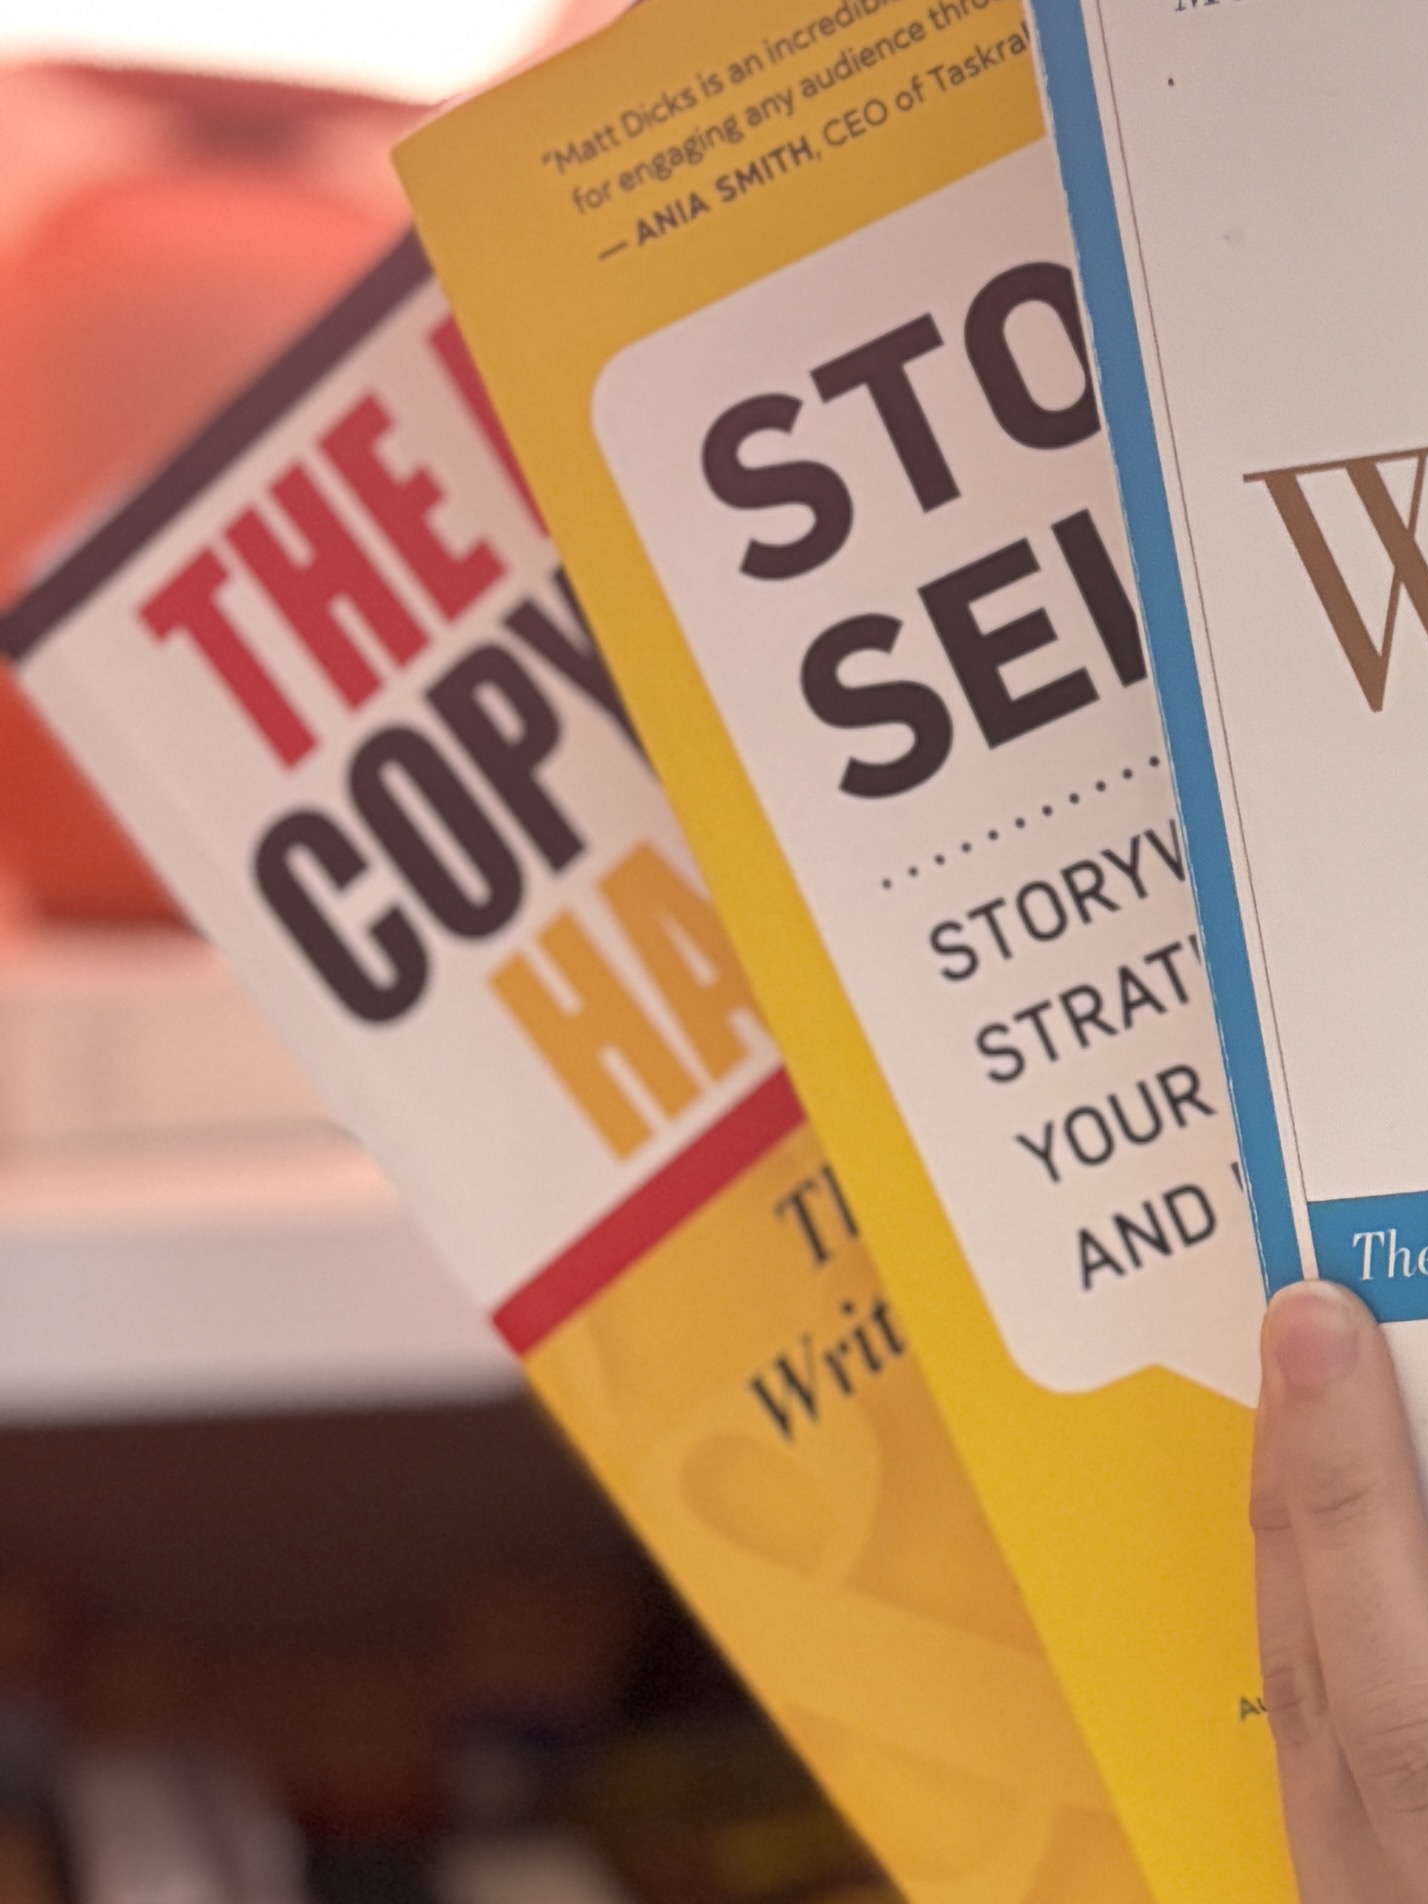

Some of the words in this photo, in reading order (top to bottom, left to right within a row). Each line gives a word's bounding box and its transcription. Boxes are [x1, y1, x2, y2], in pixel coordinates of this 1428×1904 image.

[572, 175, 612, 215] for
[619, 114, 745, 192] engaging
[746, 86, 795, 127] any
[802, 22, 926, 99] audience
[621, 85, 698, 138] Dicks
[700, 72, 724, 99] is
[728, 53, 763, 85] an
[636, 194, 711, 247] ANIA
[714, 136, 823, 202] SMITH,
[824, 99, 888, 147] CEO
[894, 76, 926, 112] of
[702, 262, 1102, 581] STO
[136, 389, 507, 774] THE
[976, 934, 1205, 1084] STRAT
[1014, 1064, 1216, 1184] YOUR
[1078, 1183, 1217, 1291] AND
